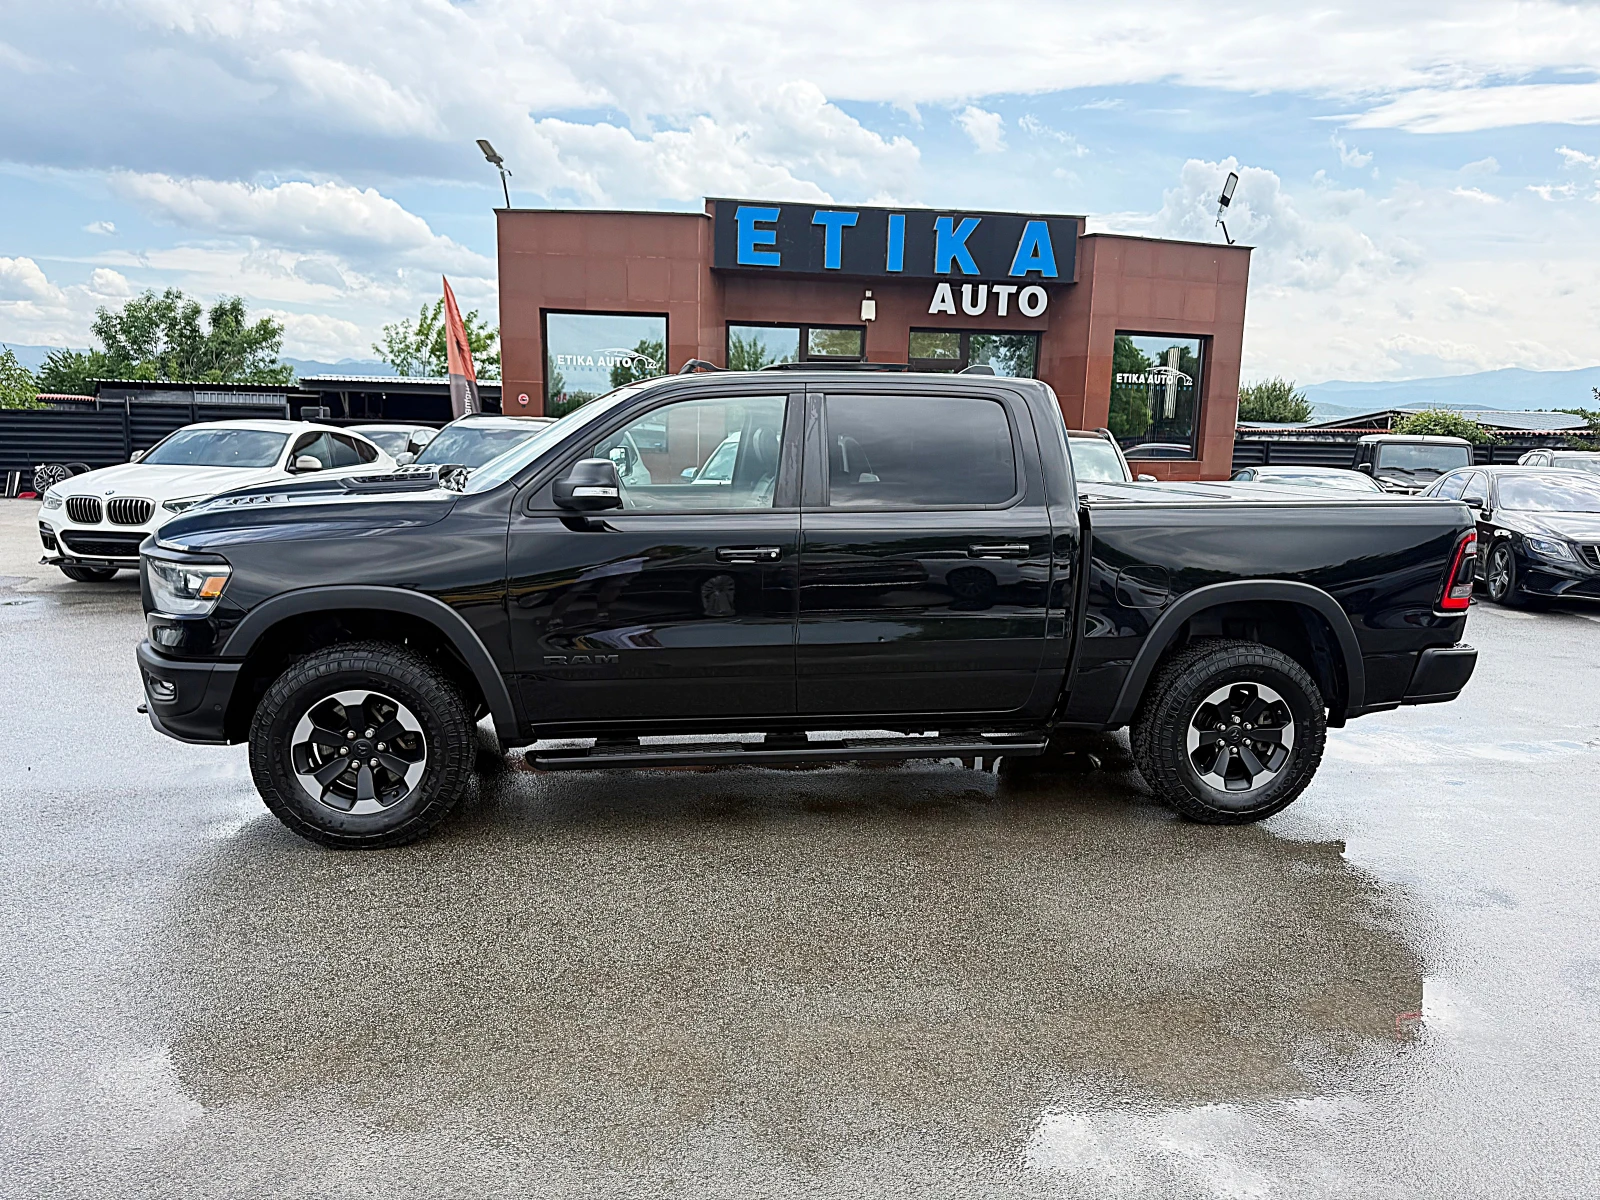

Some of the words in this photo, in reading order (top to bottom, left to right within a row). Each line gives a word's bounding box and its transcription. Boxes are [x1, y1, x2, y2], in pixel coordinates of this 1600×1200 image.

[734, 205, 1059, 278] ETIKA
[928, 282, 1048, 318] AUTO
[557, 354, 594, 367] ETIKA
[597, 356, 632, 368] AUTO
[1116, 373, 1145, 383] ETIKA
[1147, 374, 1173, 384] AUTO
[543, 654, 619, 665] RAM
